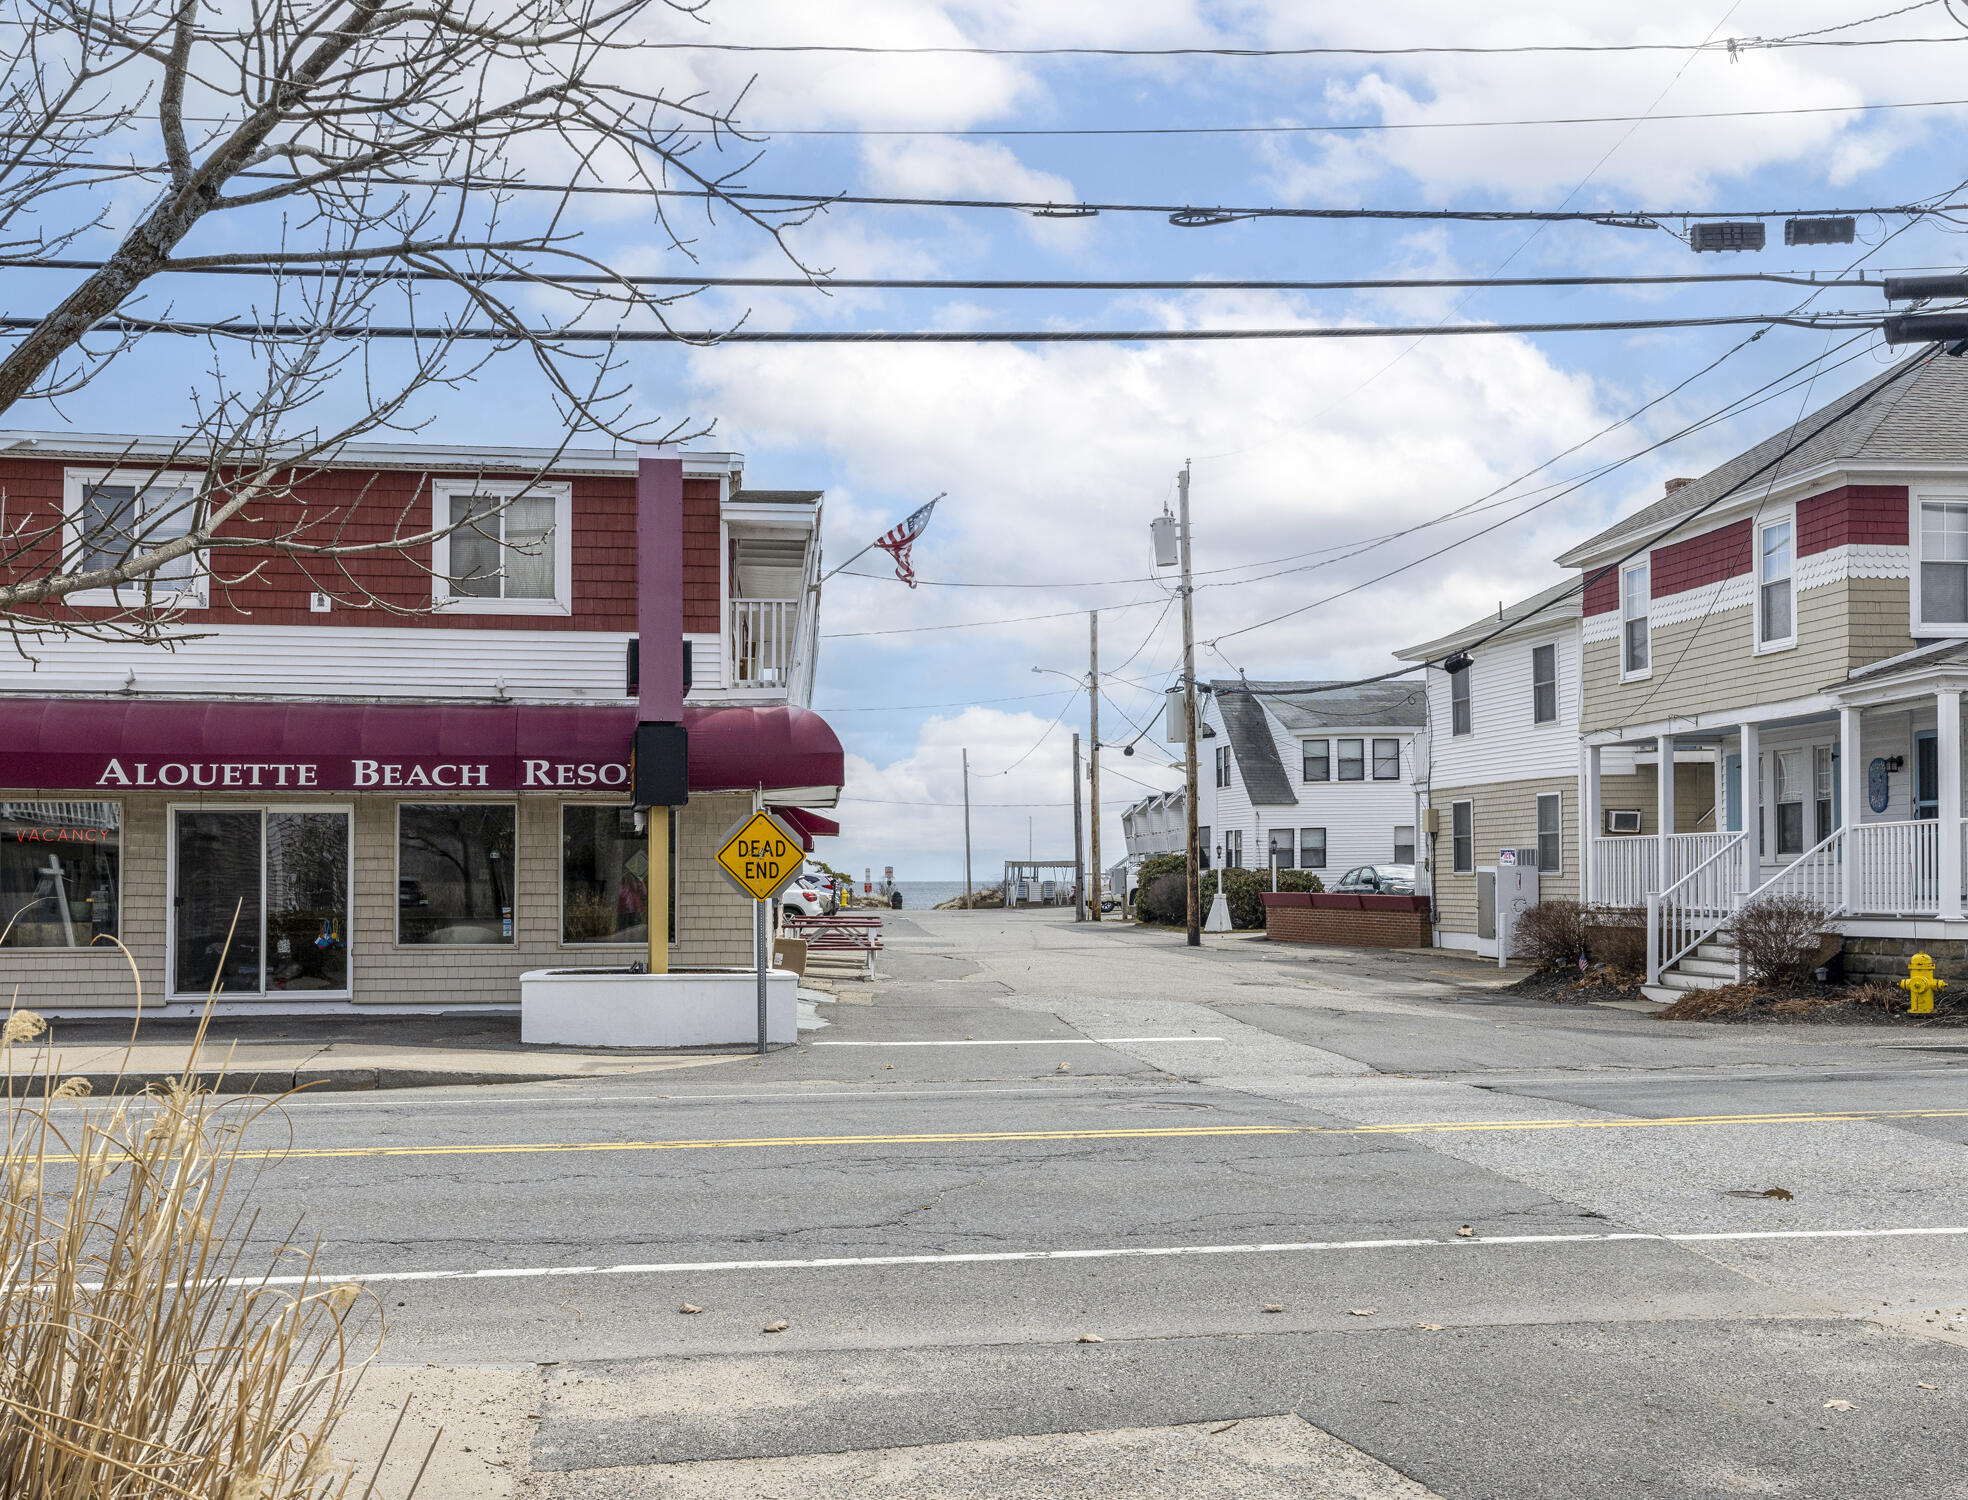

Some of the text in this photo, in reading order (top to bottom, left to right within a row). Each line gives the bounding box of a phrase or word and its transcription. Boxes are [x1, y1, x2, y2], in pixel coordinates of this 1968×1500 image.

[96, 758, 631, 786] ALOUETTE BEACH RESO
[16, 828, 110, 842] VACANCY
[738, 840, 786, 857] DEAD
[745, 861, 779, 879] END
